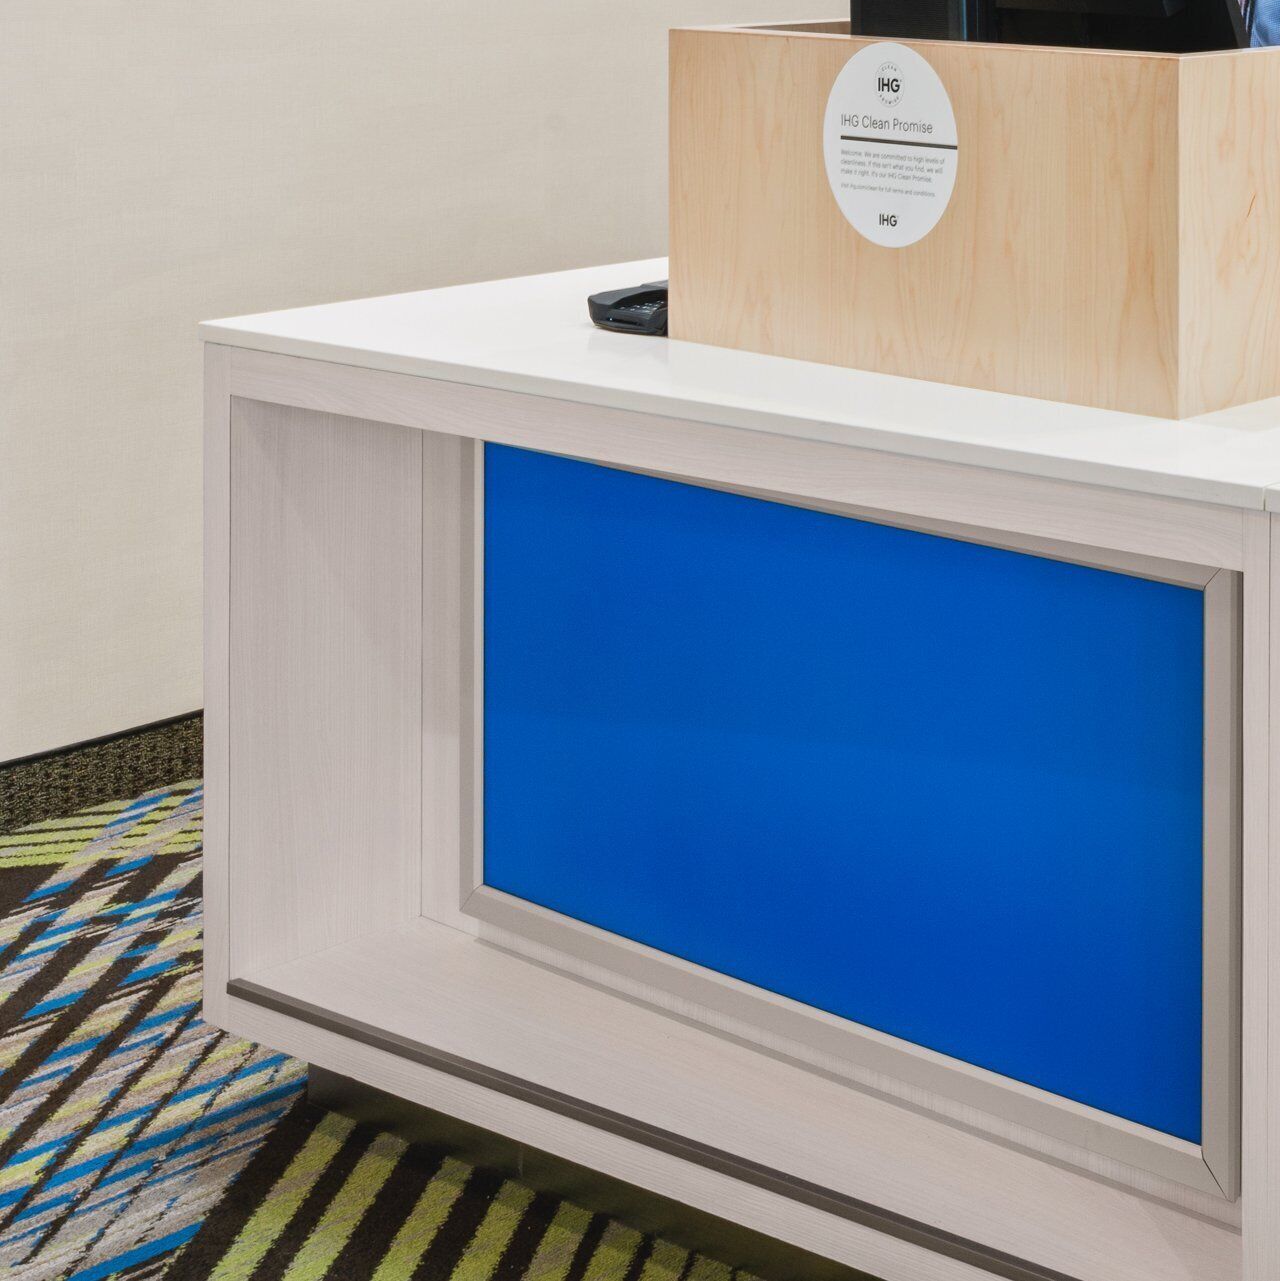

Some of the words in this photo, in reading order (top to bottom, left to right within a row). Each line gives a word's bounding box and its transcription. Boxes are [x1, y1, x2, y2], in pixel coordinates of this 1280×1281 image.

[878, 77, 900, 93] IHG
[841, 114, 859, 128] IHG
[862, 115, 890, 131] Clean
[892, 118, 933, 134] Promise
[879, 213, 897, 227] IHG
